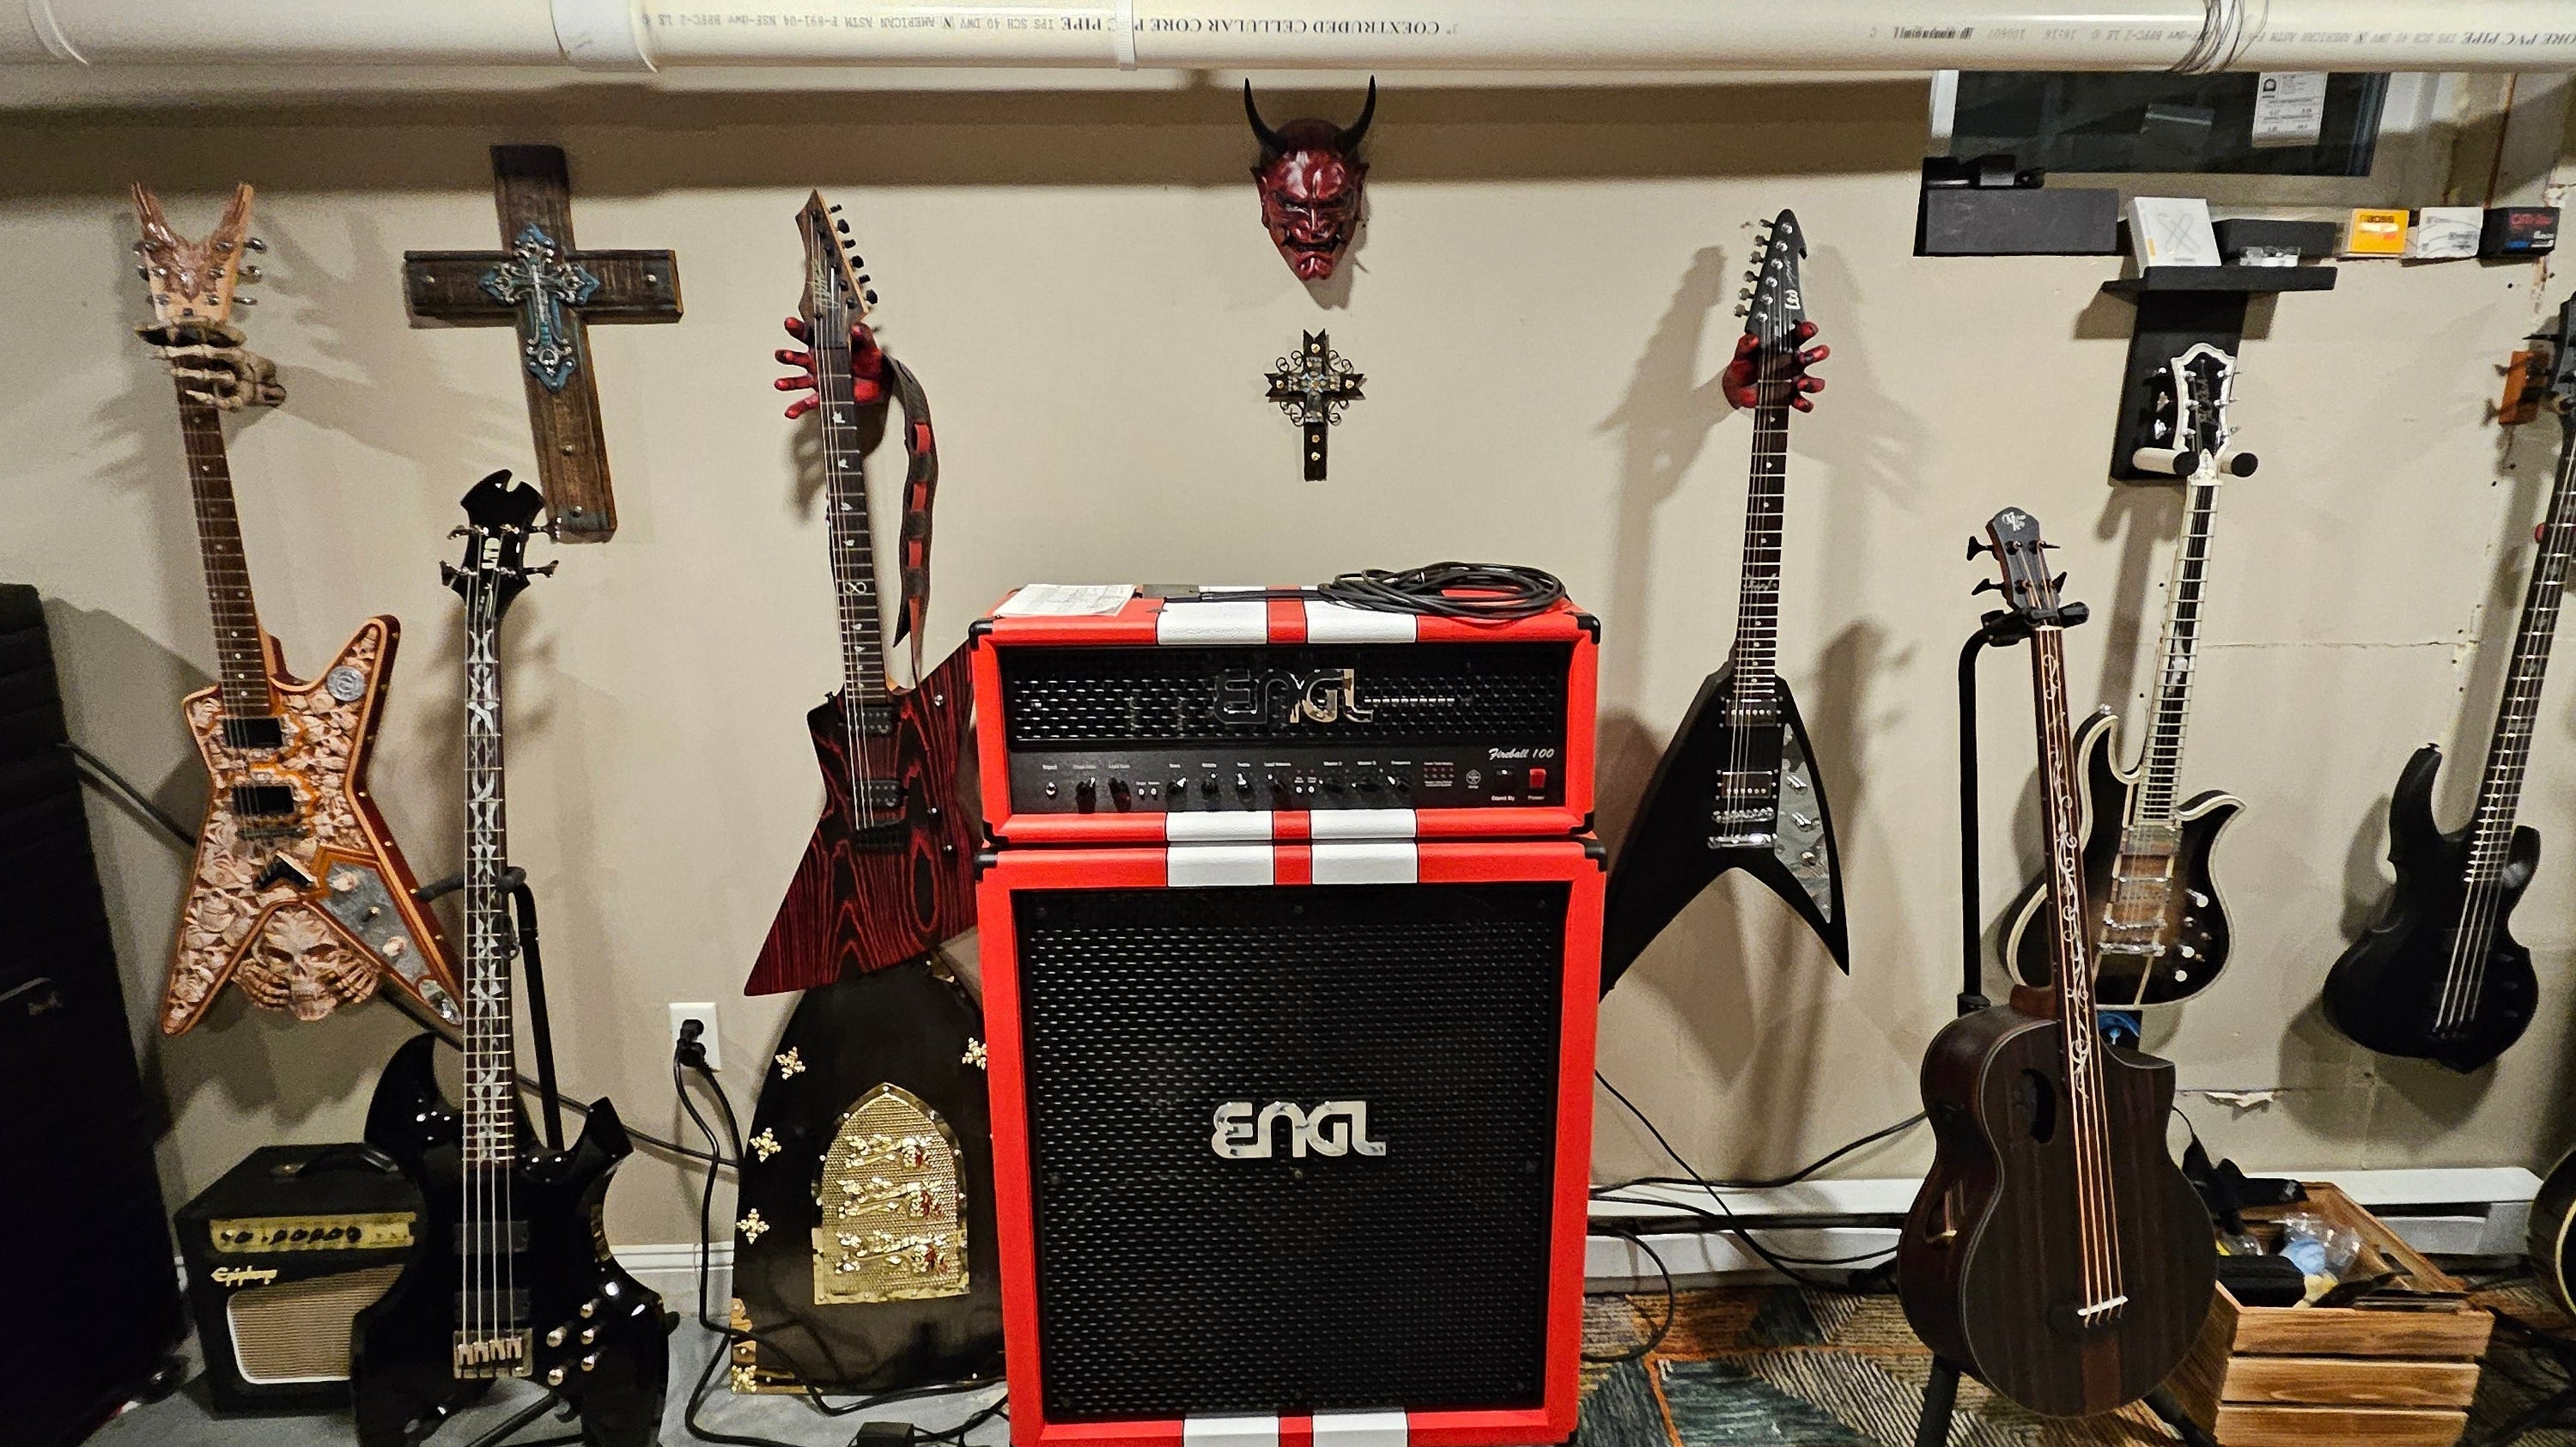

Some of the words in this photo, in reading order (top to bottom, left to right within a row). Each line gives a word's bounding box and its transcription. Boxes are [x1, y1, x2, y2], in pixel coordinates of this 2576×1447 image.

[844, 16, 873, 27] ASTM
[879, 17, 935, 28] AMERICAN
[960, 18, 980, 29] DWV
[987, 18, 1000, 29] 40
[1007, 18, 1028, 29] SCH
[1060, 17, 1102, 32] PIPE
[1106, 17, 1145, 33] PC
[1150, 18, 1202, 33] CORE
[1207, 19, 1307, 35] CELLULAR
[1313, 20, 1439, 35] COEXTRUDED
[2460, 32, 2500, 46] PIPE
[481, 538, 501, 569] LTD
[1215, 667, 1374, 725] ENGL
[1487, 747, 1530, 761] Fireball
[1532, 748, 1555, 758] 100
[1211, 1100, 1387, 1159] ENGL
